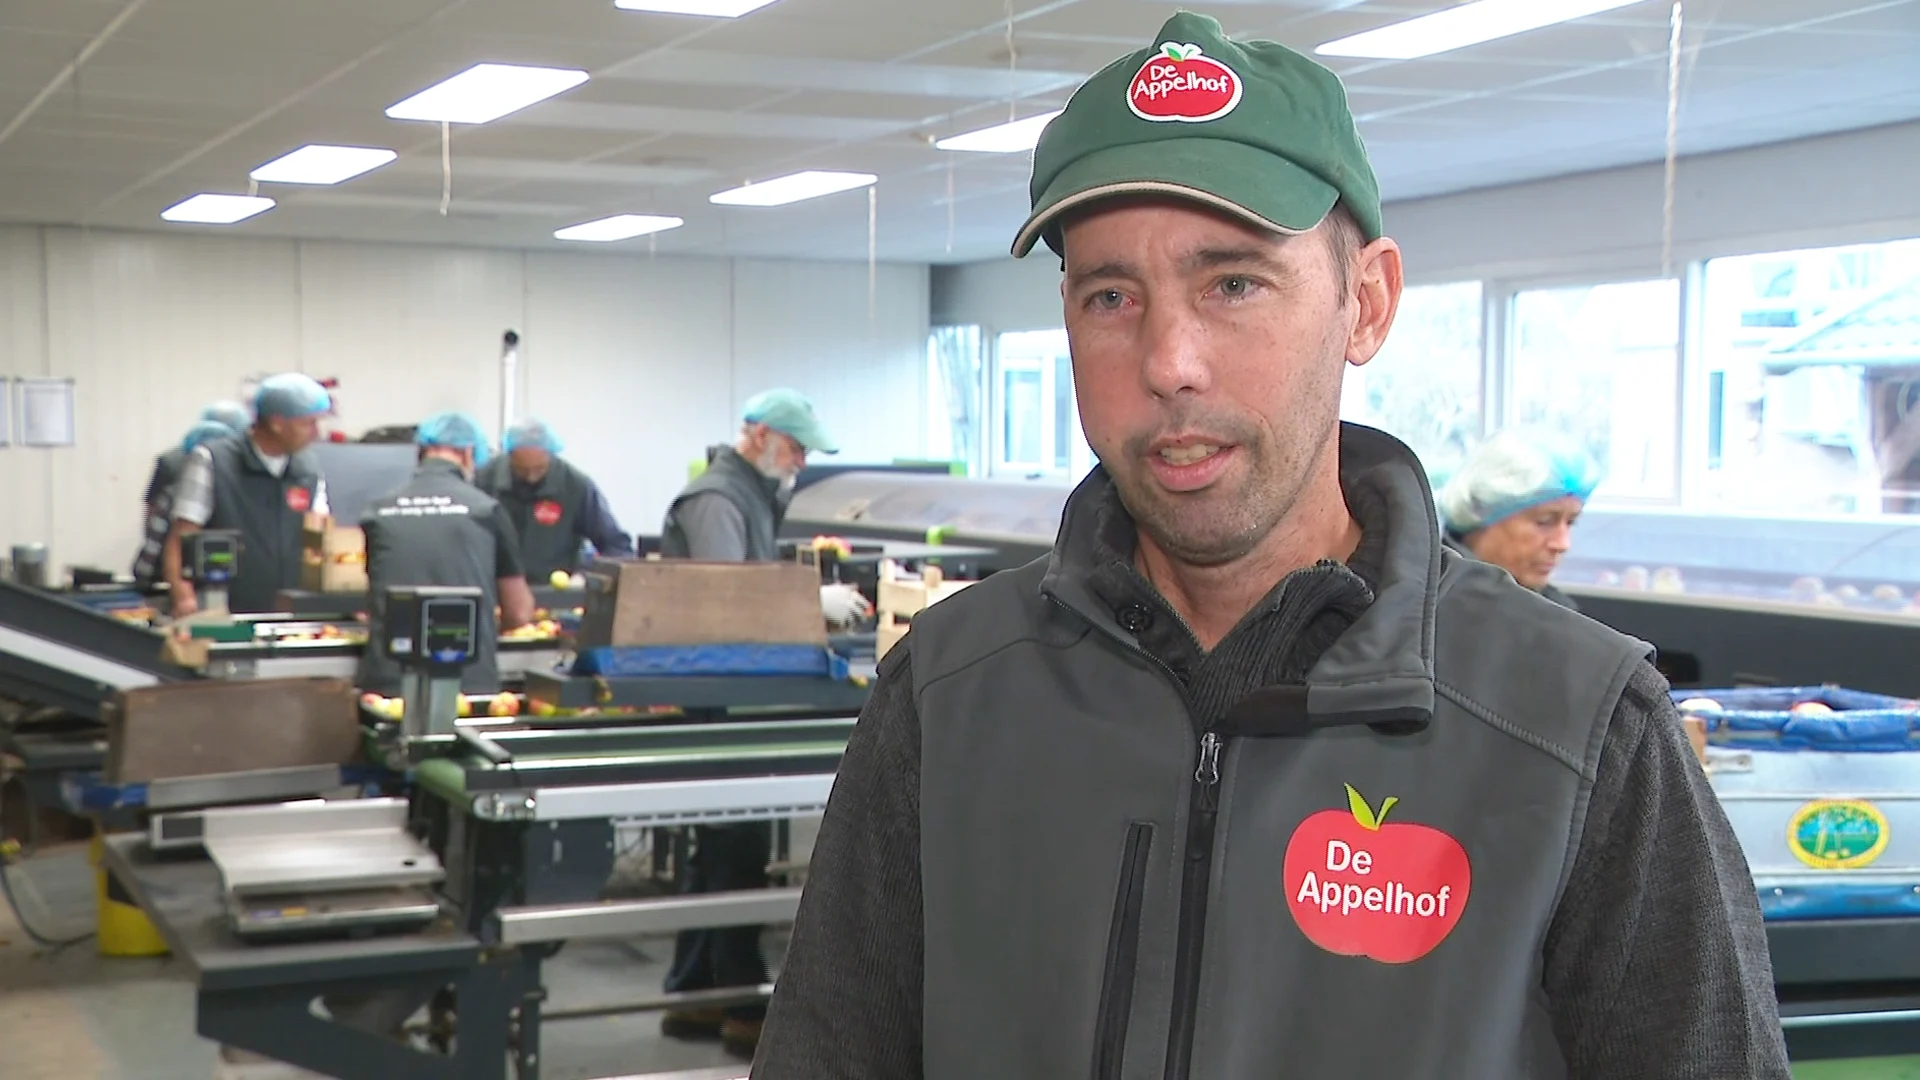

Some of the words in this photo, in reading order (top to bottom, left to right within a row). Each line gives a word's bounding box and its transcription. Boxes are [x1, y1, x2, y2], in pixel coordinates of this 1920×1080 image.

[1134, 71, 1228, 100] Appelhof
[1150, 65, 1178, 81] De
[1327, 840, 1373, 874] De
[1297, 871, 1451, 917] Appelhof
